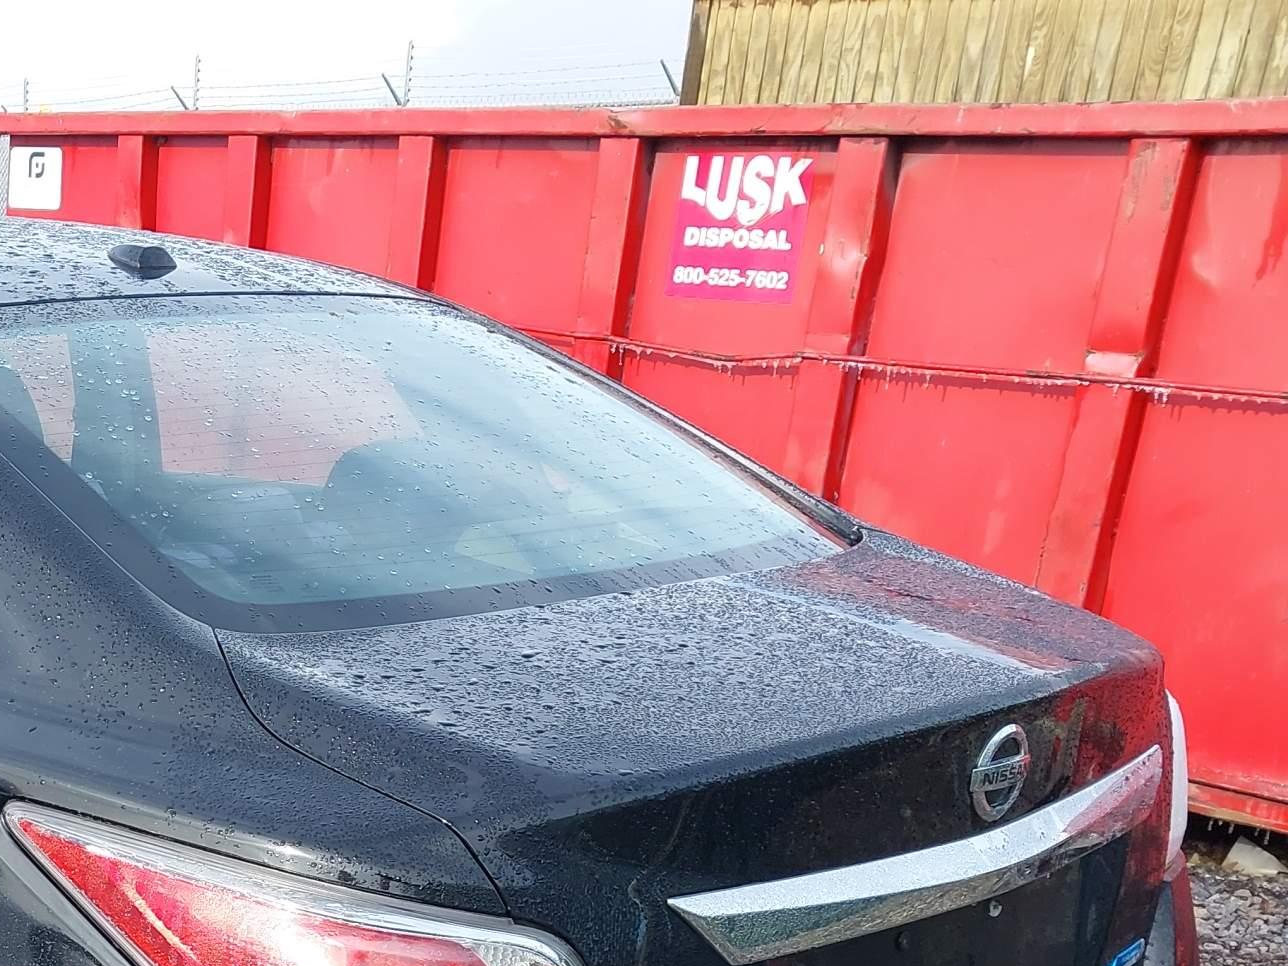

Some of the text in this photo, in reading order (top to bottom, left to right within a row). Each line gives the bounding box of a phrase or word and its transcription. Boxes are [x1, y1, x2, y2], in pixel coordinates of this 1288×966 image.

[680, 155, 814, 226] LUSK
[683, 226, 792, 250] DISPOSAL
[673, 266, 789, 289] 800-525-7602
